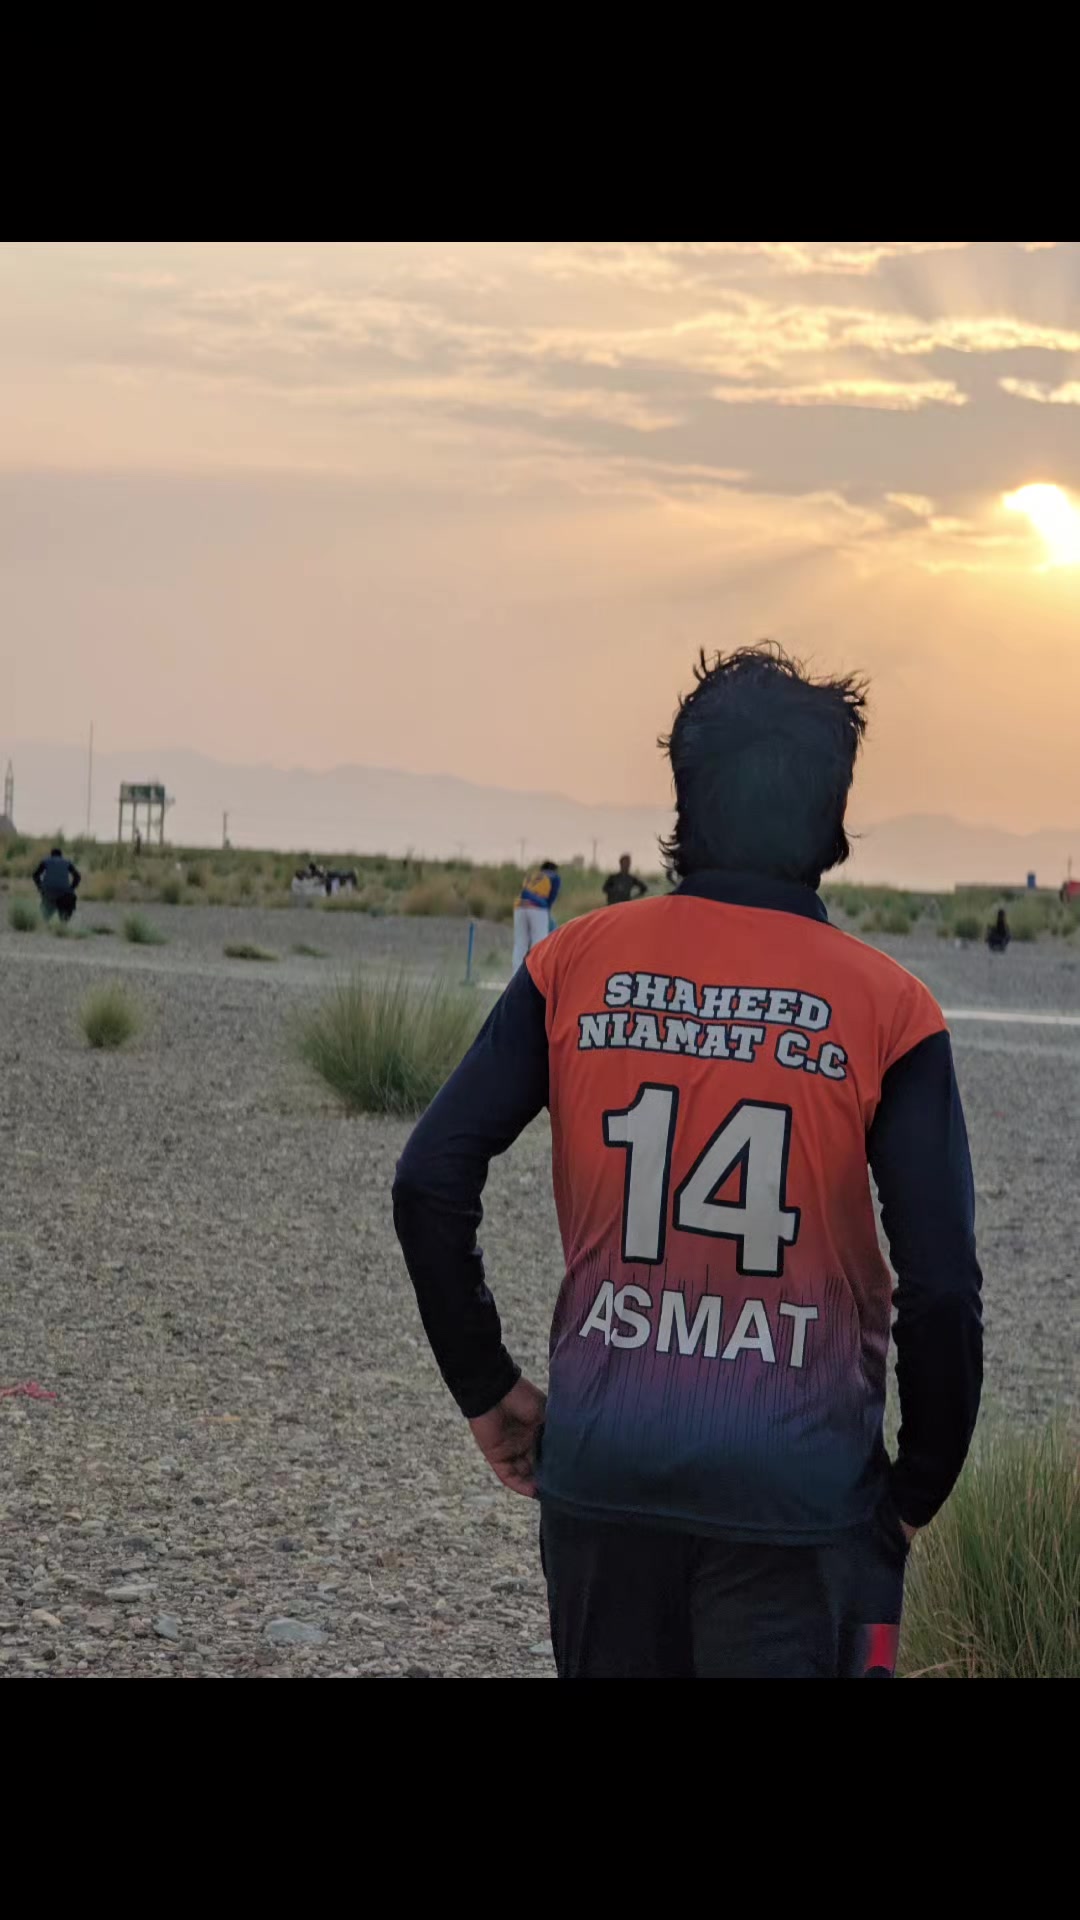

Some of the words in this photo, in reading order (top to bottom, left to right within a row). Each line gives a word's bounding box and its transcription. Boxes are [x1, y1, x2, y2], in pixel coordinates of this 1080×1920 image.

[605, 972, 832, 1032] SHAHEED
[578, 1013, 766, 1062] NIAMAT
[775, 1030, 848, 1080] C.C
[603, 1082, 800, 1277] 14
[578, 1280, 819, 1368] ASMAT
